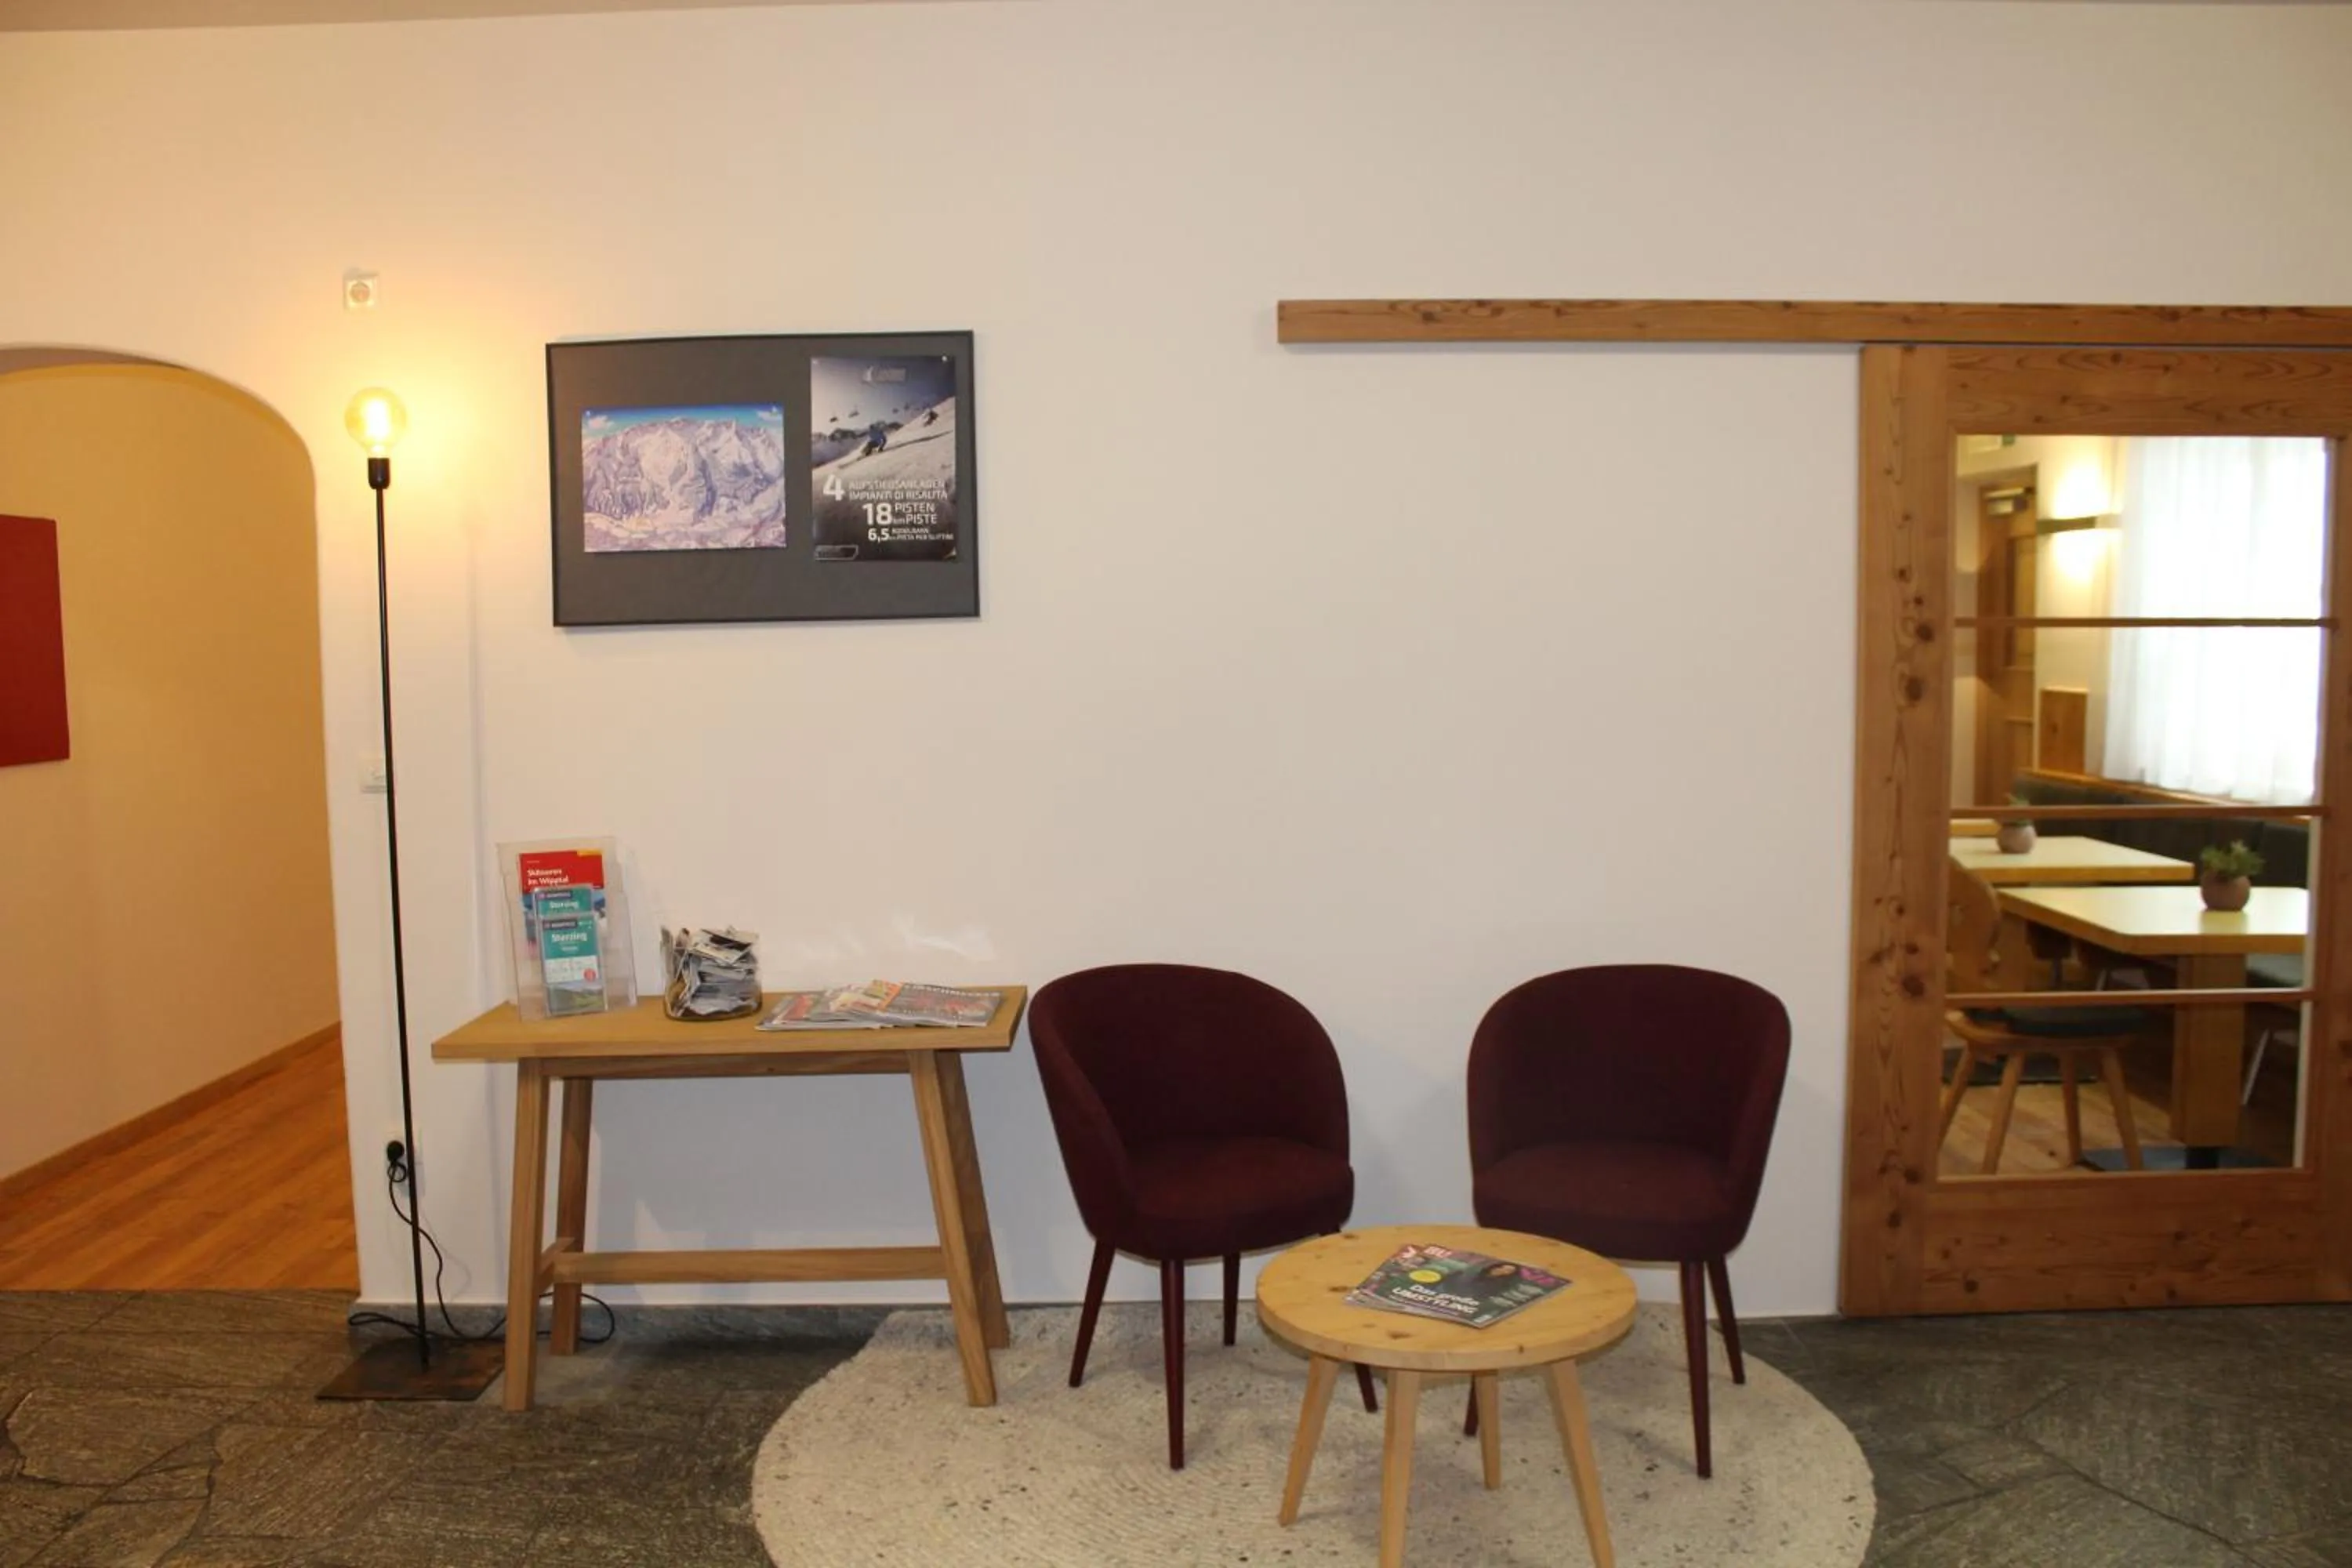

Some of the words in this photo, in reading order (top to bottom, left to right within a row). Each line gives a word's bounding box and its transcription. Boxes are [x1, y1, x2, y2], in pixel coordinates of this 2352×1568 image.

[823, 474, 844, 501] 4
[848, 491, 892, 500] IMPIANTI
[895, 491, 904, 499] DI
[906, 490, 947, 499] RISALITA
[862, 503, 893, 525] 18
[895, 503, 935, 513] PISTEN
[906, 514, 938, 524] PISTE
[868, 528, 890, 543] 6,5
